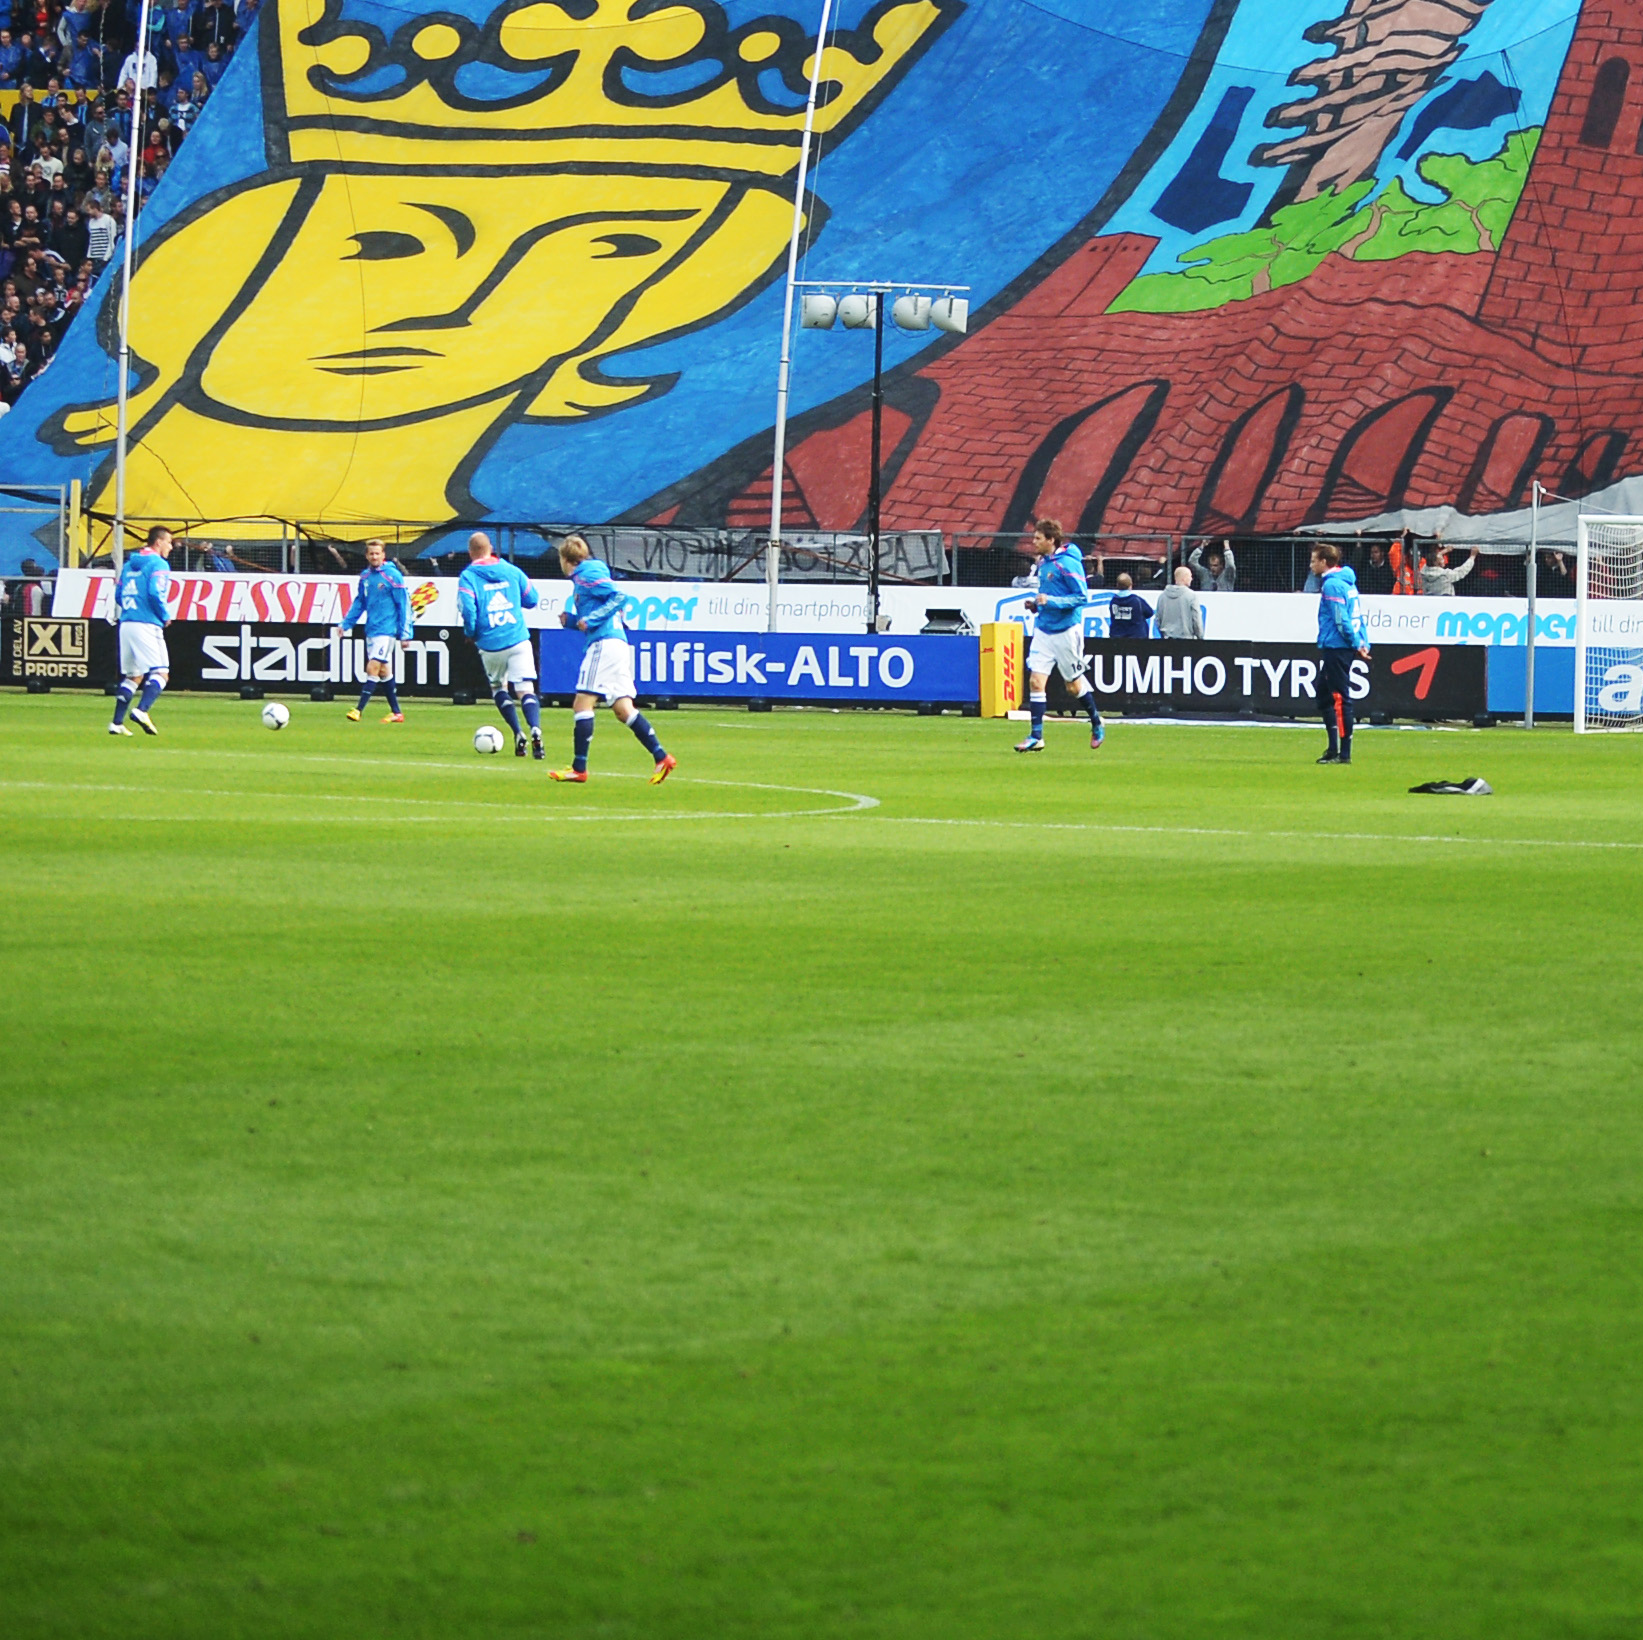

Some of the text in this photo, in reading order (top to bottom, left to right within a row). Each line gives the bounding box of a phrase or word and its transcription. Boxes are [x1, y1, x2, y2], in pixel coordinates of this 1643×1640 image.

[80, 575, 359, 623] ERESSEN
[709, 598, 728, 615] till
[734, 598, 760, 615] din
[488, 610, 517, 628] ICA
[1363, 609, 1392, 628] dda
[1398, 614, 1430, 628] ner
[1592, 615, 1614, 633] till
[29, 623, 83, 656] XL
[25, 662, 88, 678] PROFFS
[629, 641, 914, 688] ilfisk-ALTO
[1004, 642, 1015, 702] DHL
[1083, 654, 1370, 700] KUMHO TYRS
